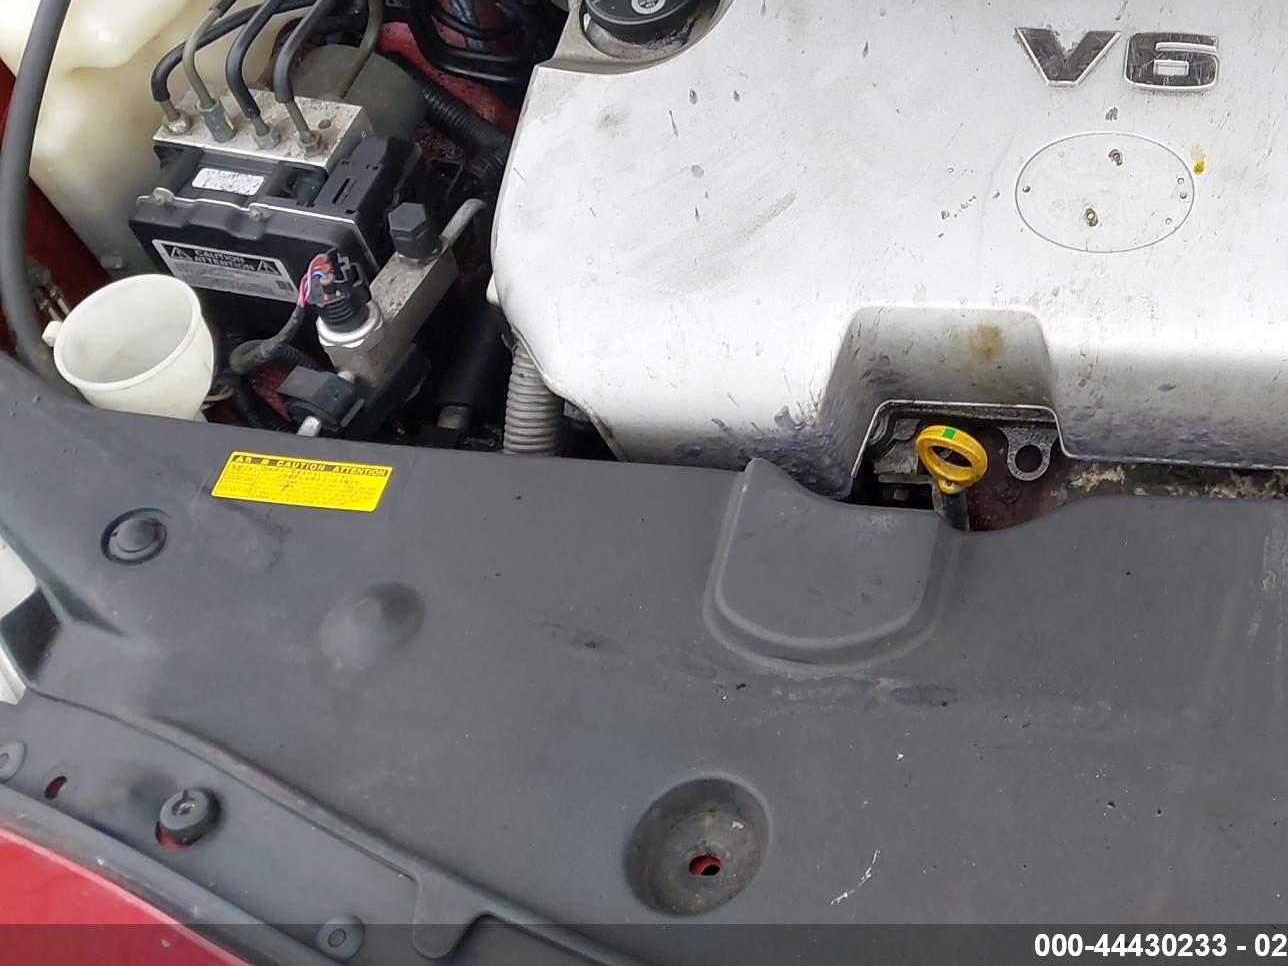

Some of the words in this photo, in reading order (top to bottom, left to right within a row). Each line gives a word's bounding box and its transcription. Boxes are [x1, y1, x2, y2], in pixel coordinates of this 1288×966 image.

[1014, 26, 1220, 91] V6
[194, 249, 245, 263] CAUTION
[194, 256, 255, 271] ATTENTION
[276, 460, 326, 471] CAUTION
[333, 466, 387, 476] ATTENTION
